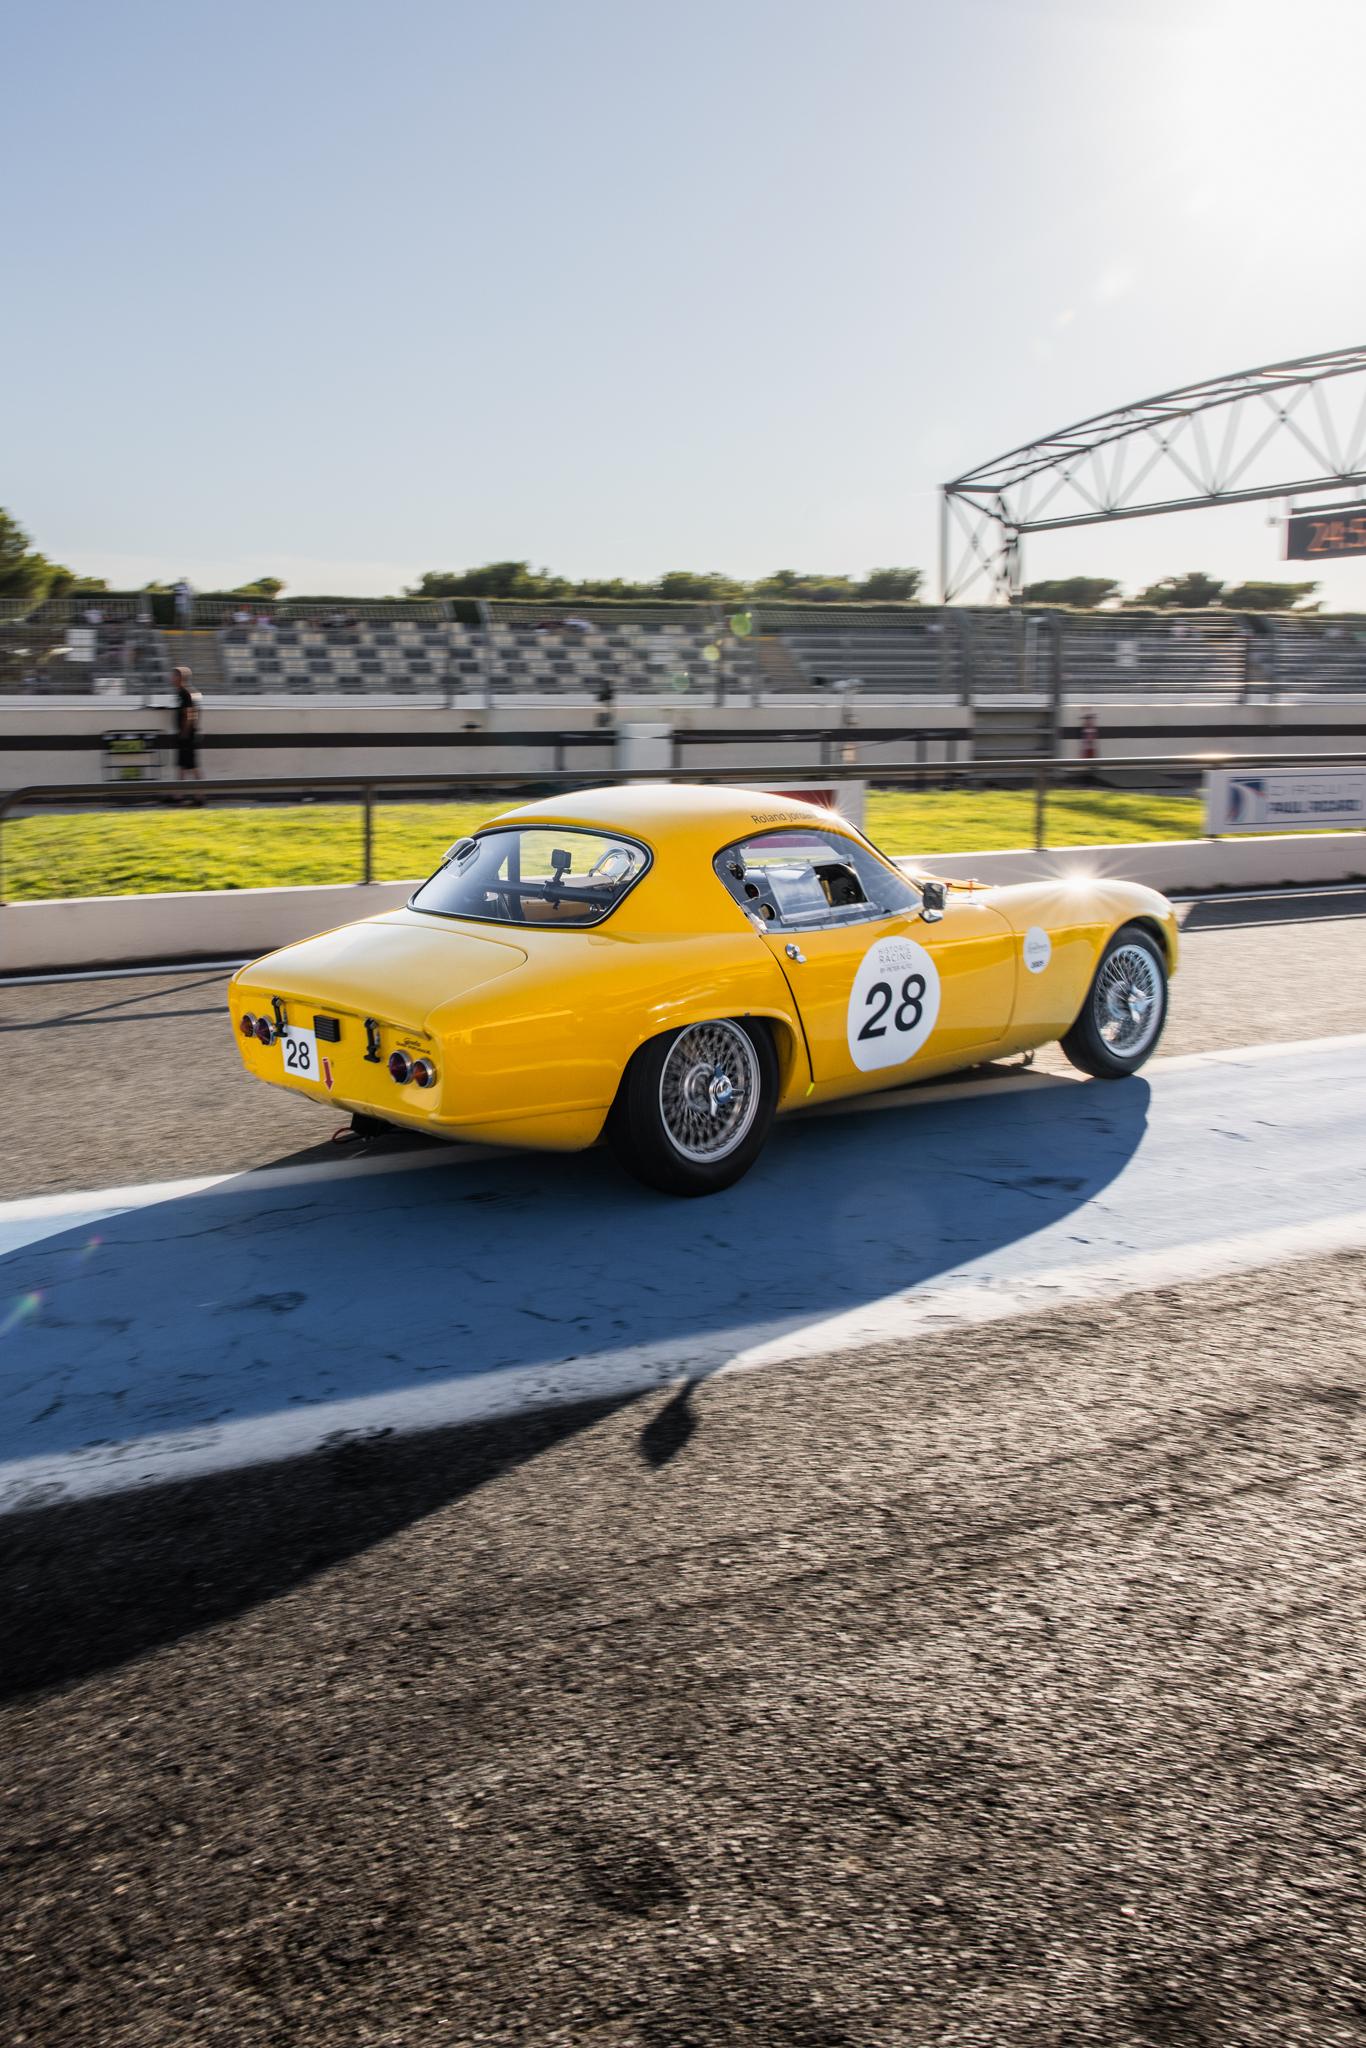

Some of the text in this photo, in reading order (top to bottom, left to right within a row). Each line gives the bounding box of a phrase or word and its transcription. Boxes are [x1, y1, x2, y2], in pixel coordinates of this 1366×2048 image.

[751, 813, 787, 824] Roland
[879, 951, 912, 963] RACING
[857, 973, 926, 1041] 28
[286, 1039, 311, 1070] 28
